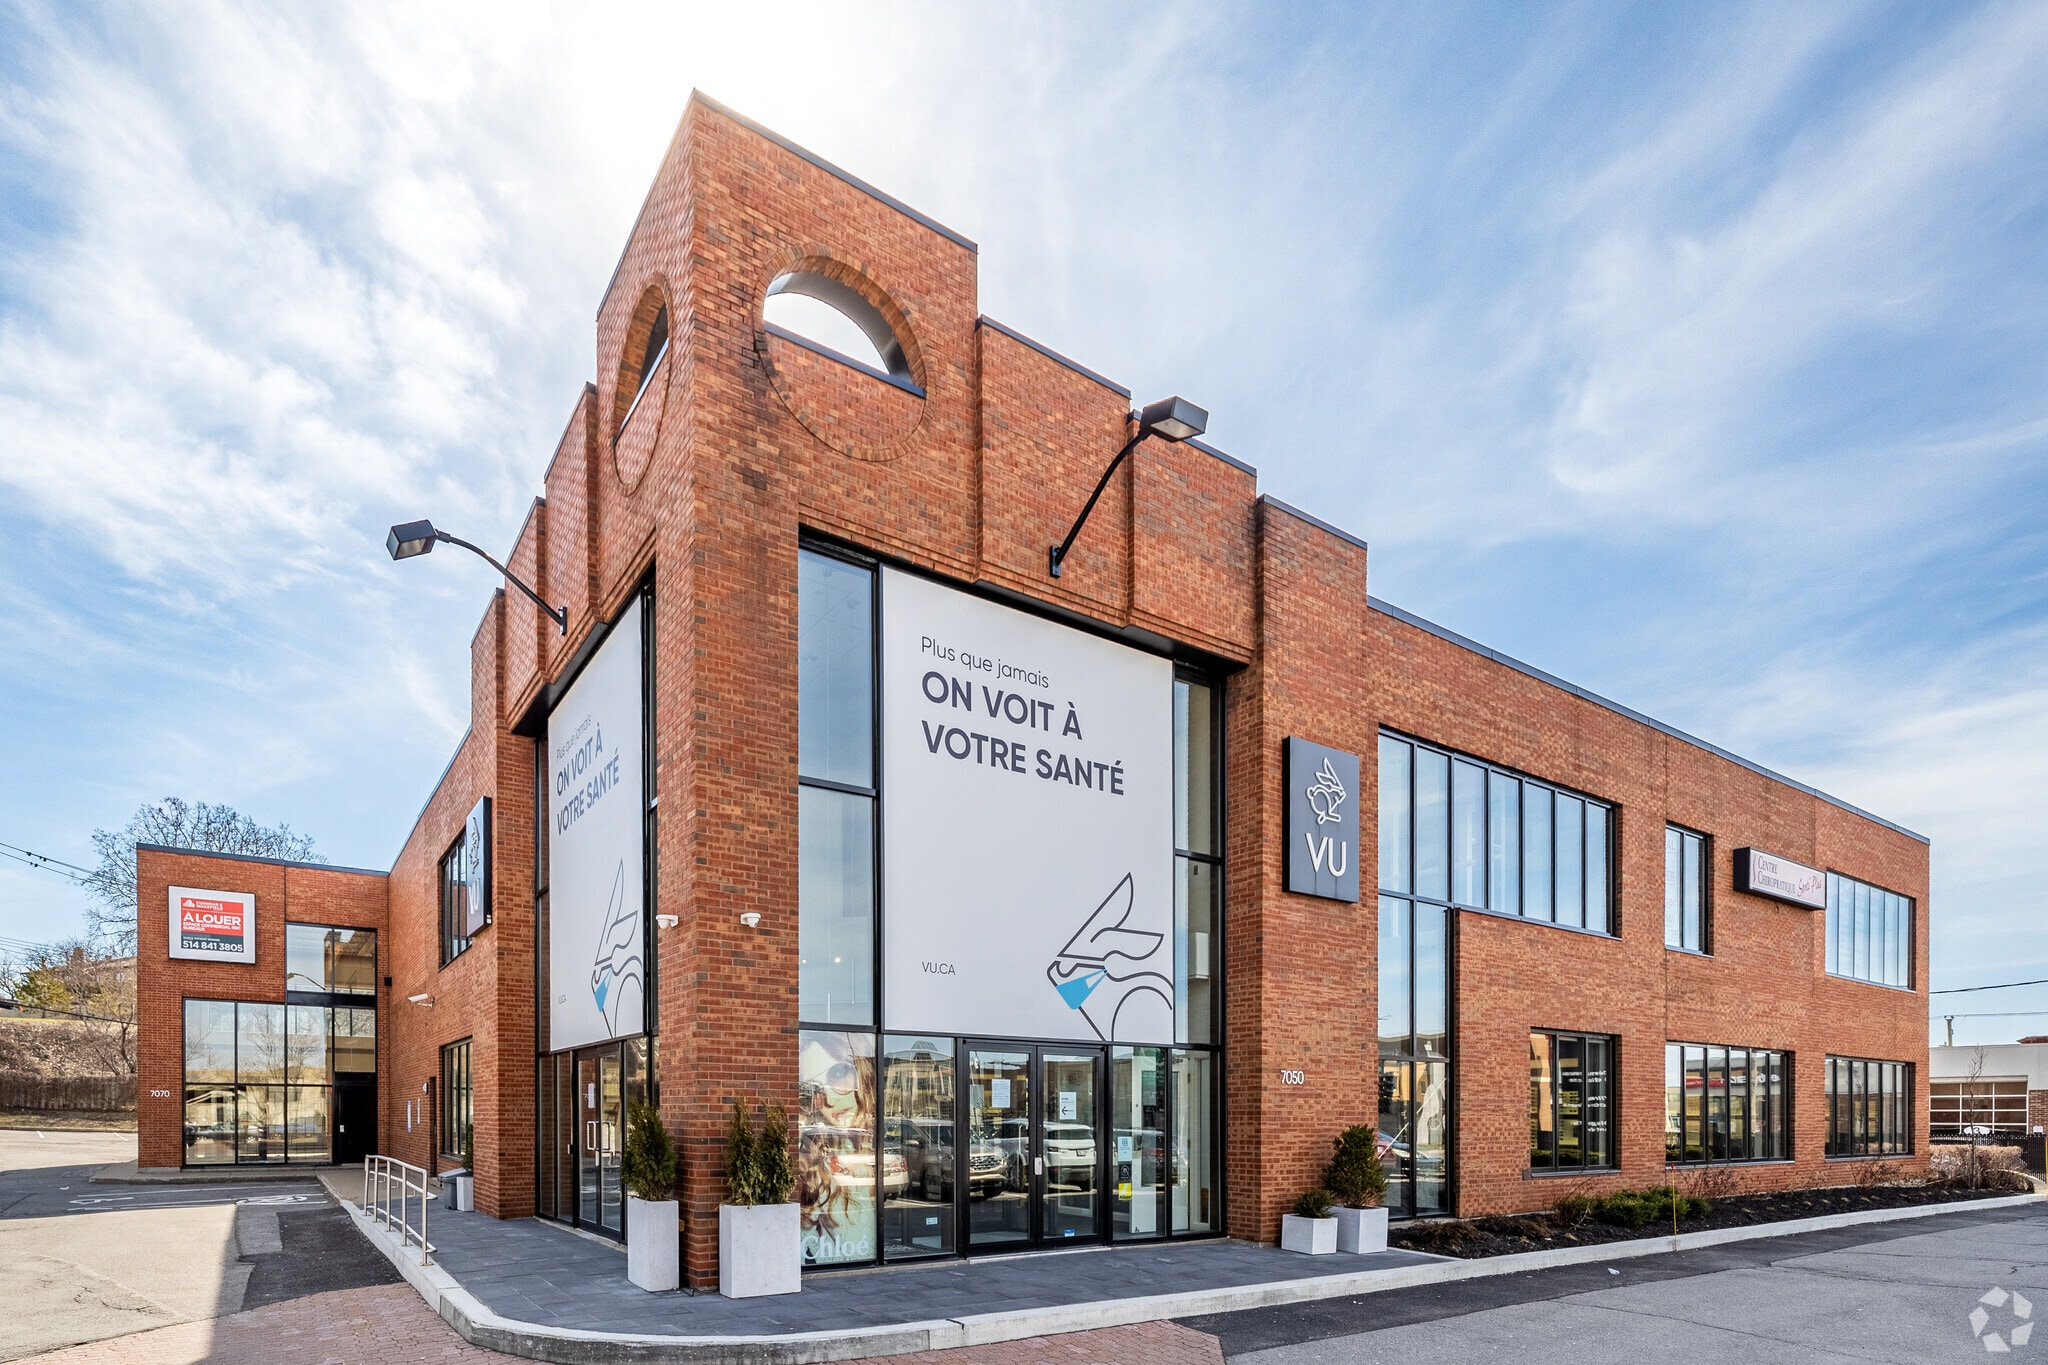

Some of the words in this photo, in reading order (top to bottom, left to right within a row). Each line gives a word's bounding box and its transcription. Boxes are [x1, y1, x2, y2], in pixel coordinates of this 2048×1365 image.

[922, 635, 956, 661] Plus
[960, 651, 993, 671] que
[996, 658, 1050, 688] jamais
[922, 670, 972, 712] ON
[982, 685, 1055, 731] VOIT
[1062, 701, 1083, 740] À
[556, 763, 570, 797] ON
[571, 736, 593, 781] VOIT
[595, 722, 603, 759] À
[921, 719, 1027, 774] VOTRE
[1036, 748, 1125, 796] SANTÉ
[556, 788, 585, 836] VOTRE
[586, 747, 620, 809] SANTÉ
[1305, 832, 1347, 877] VU
[195, 913, 242, 926] LOUER
[183, 940, 200, 949] 514
[201, 941, 217, 950] 841
[219, 943, 243, 952] 3805
[921, 960, 956, 976] VU.CA
[150, 1090, 170, 1098] 7070
[1280, 1069, 1305, 1085] 7050
[801, 1234, 869, 1260] Chloé
